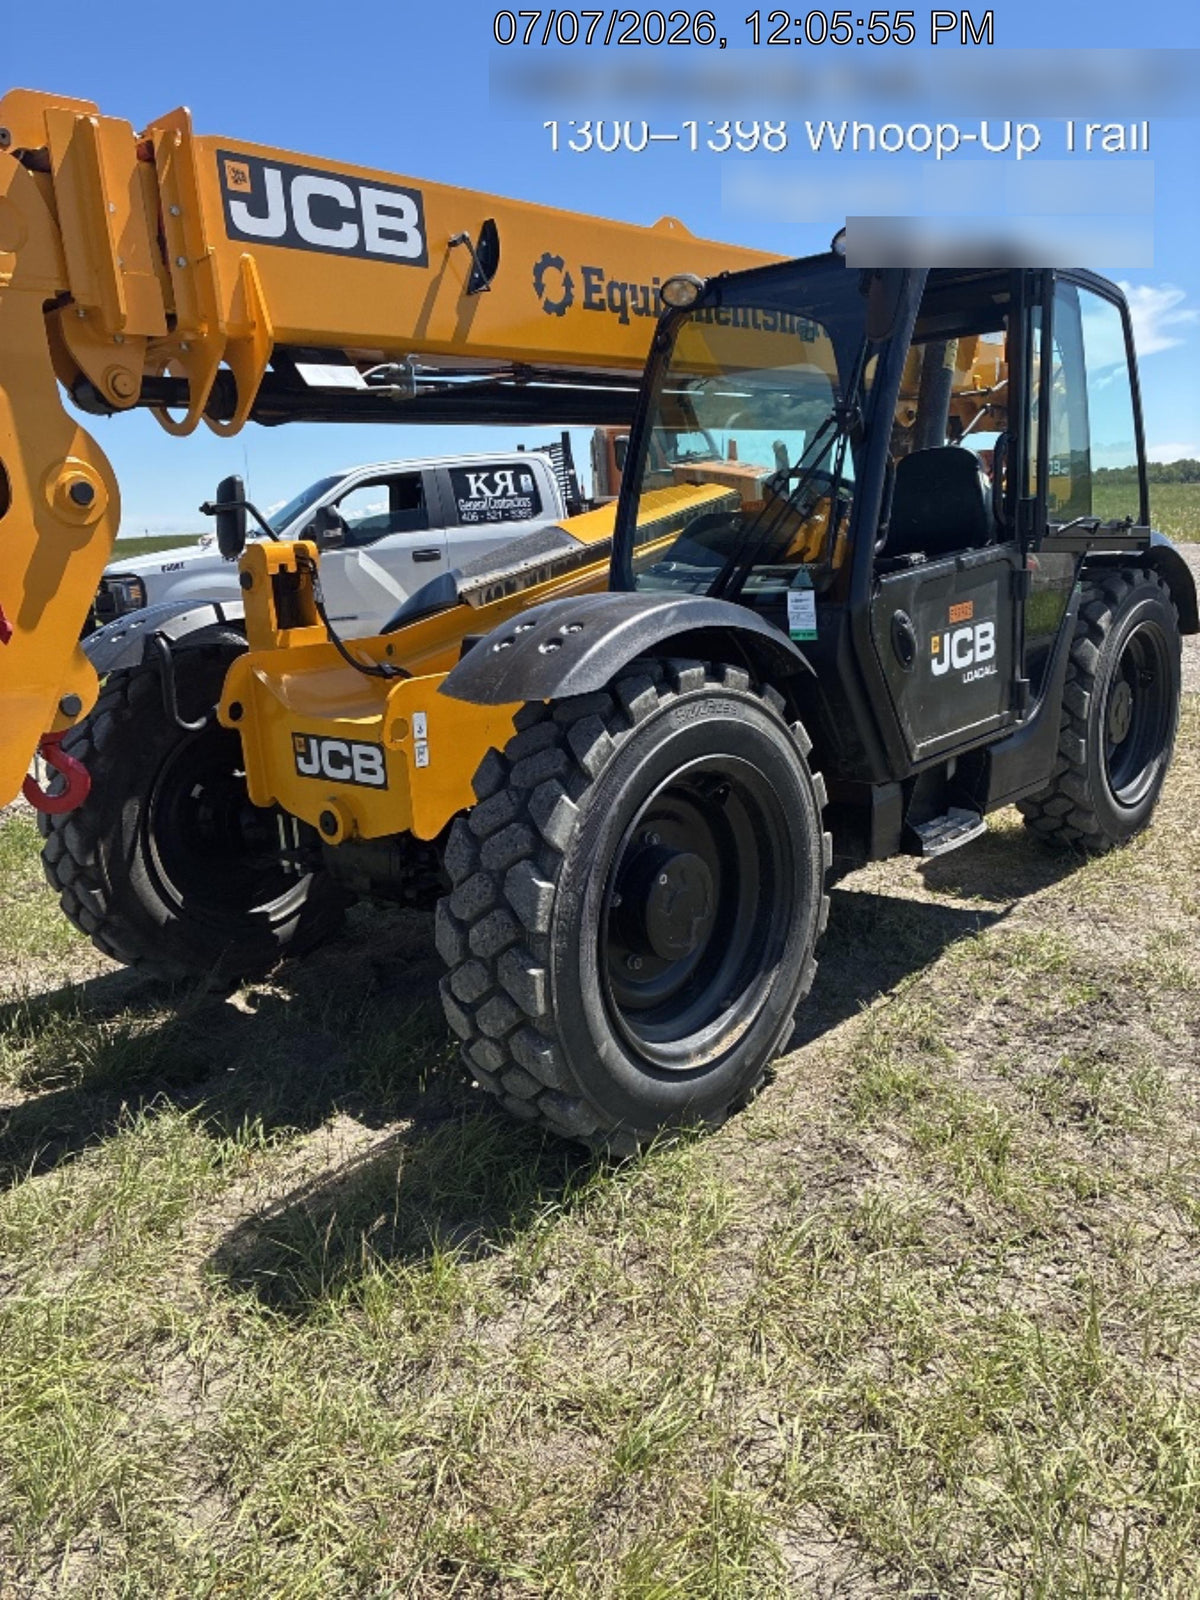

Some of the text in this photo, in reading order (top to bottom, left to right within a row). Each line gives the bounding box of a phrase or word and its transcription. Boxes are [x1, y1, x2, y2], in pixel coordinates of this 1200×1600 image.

[229, 167, 424, 259] JCB
[931, 621, 997, 677] JCB
[297, 739, 385, 785] JCB
